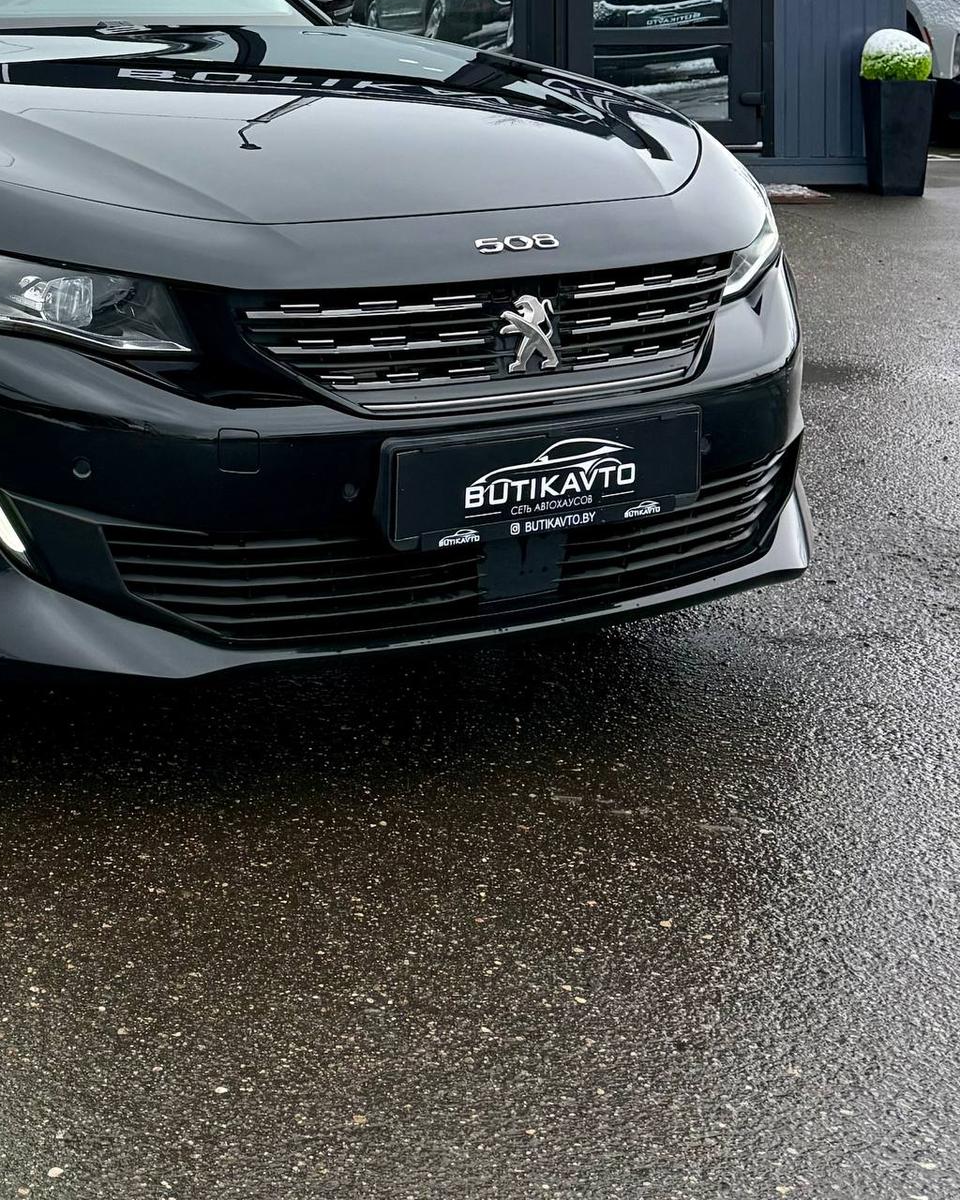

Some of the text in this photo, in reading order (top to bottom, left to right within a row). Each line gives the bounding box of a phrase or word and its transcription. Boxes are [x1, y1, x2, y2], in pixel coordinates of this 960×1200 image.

[473, 233, 560, 254] 508
[464, 462, 636, 509] BUTIKAVTO
[510, 494, 594, 516] СЕТЬ АВТОХАУСОВ
[623, 503, 661, 518] BUTIKAVTO
[524, 510, 597, 533] BUTIKAVTO.BY
[438, 533, 481, 548] BUTIKAVTO
